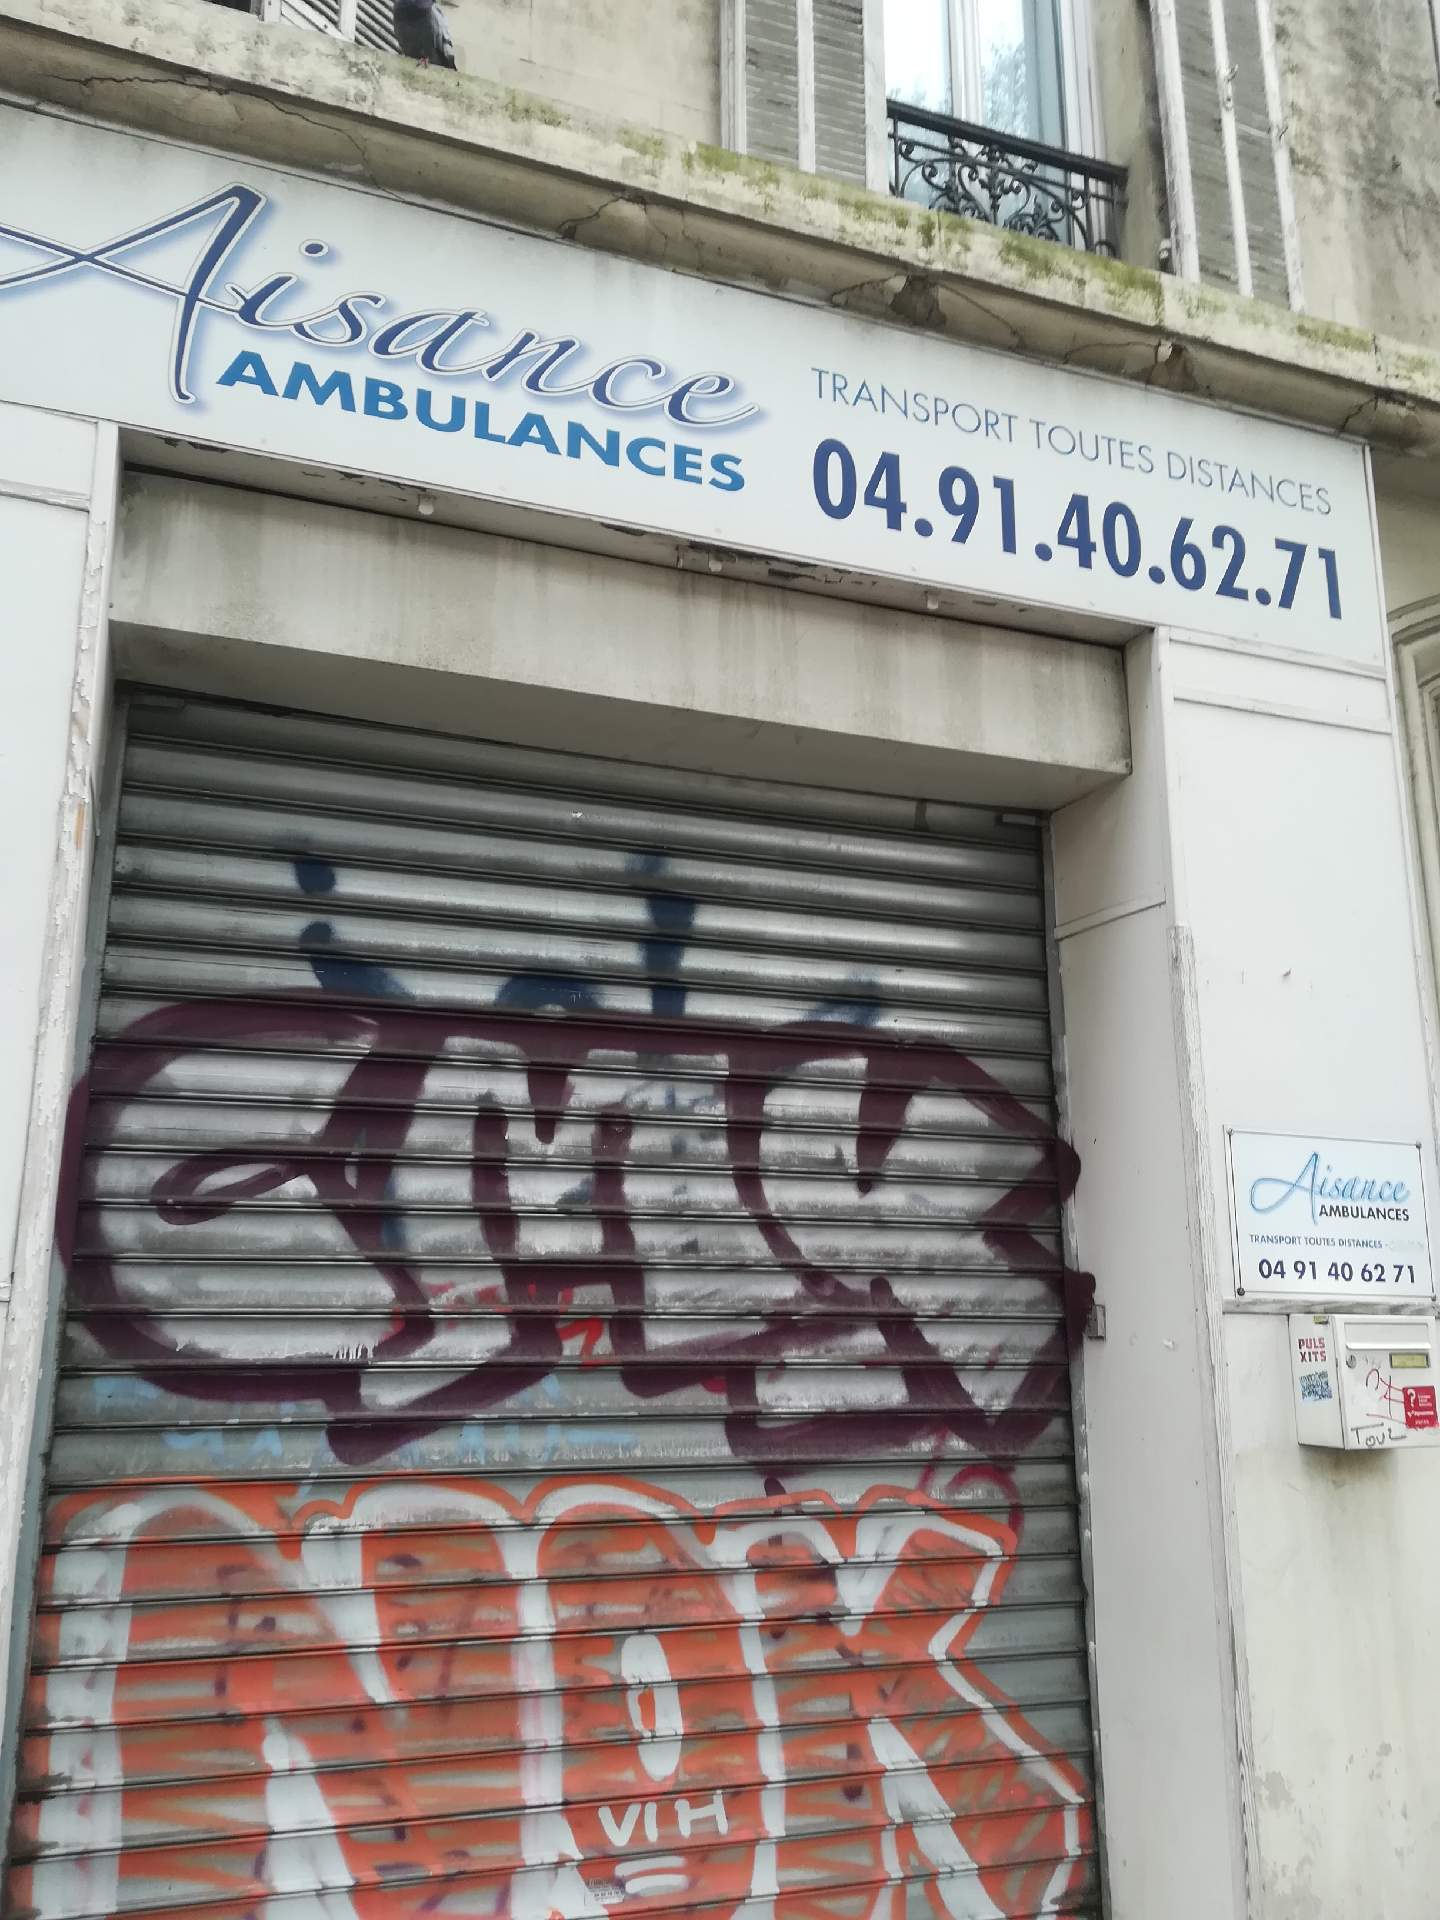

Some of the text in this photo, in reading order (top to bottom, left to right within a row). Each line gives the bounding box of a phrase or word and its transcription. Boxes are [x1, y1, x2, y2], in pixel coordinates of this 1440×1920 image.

[0, 183, 760, 425] Aisance
[216, 350, 746, 492] AMBULANCES
[812, 367, 1333, 516] TRANSPORT TOUTES DISTANCES
[812, 438, 1343, 620] 04.91.40.62.71
[1250, 1152, 1410, 1225] Aisance
[1250, 1234, 1301, 1246] TRANSPORT
[1304, 1236, 1336, 1247] TOUTES
[1338, 1237, 1383, 1249] DISTANCES
[1319, 1205, 1410, 1221] AMBULANCES
[1258, 1258, 1416, 1284] 04 91 40 62 71
